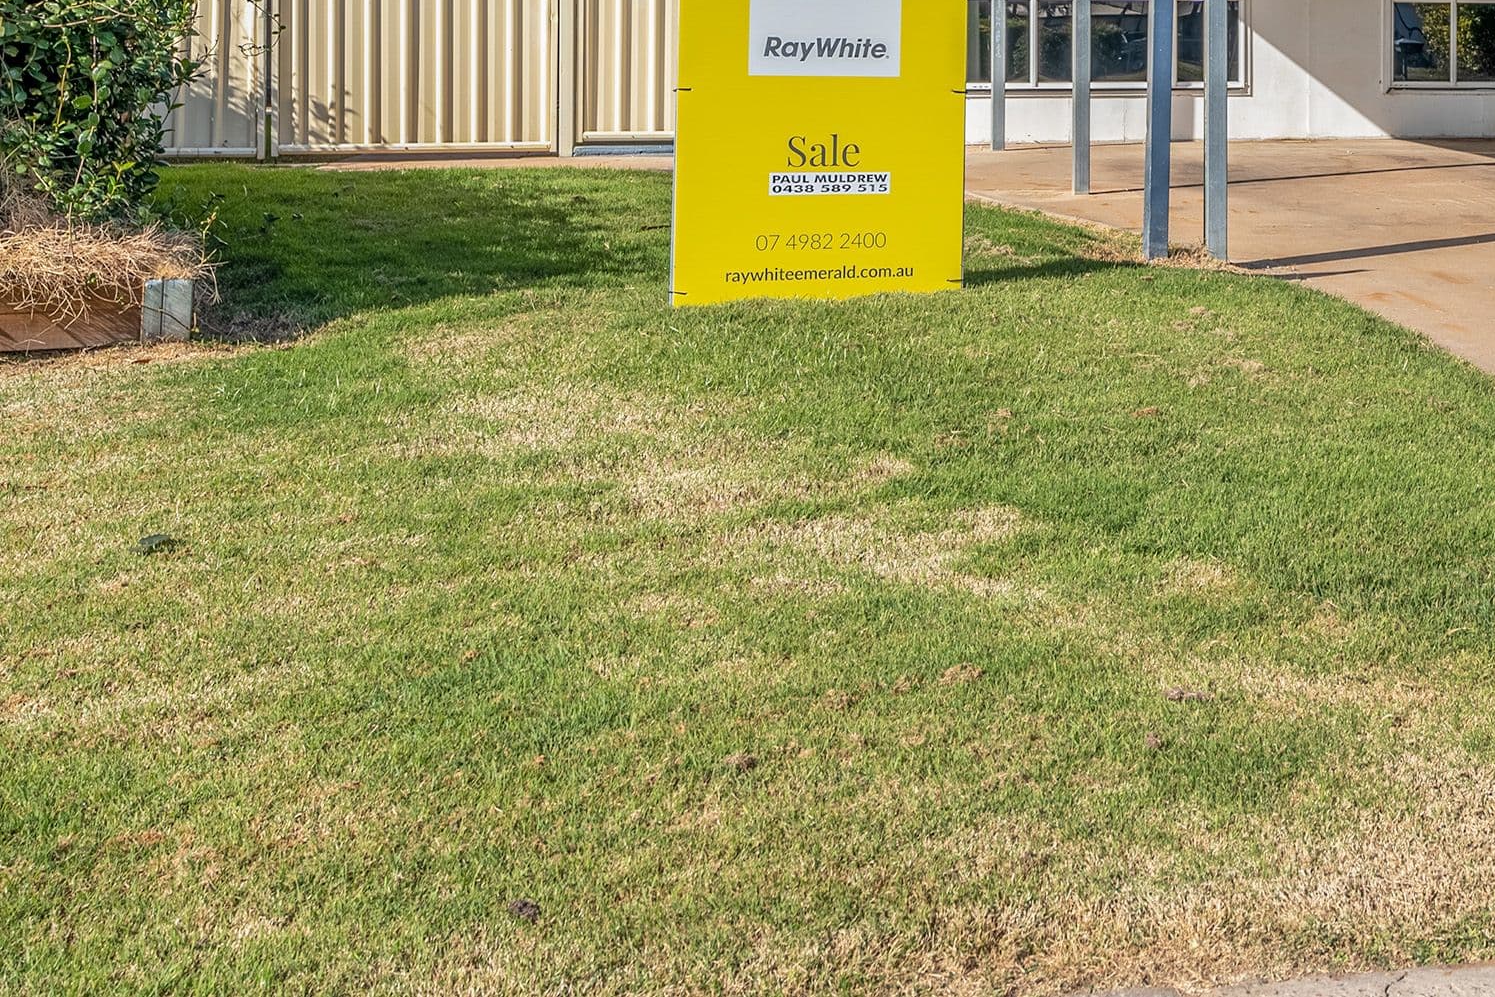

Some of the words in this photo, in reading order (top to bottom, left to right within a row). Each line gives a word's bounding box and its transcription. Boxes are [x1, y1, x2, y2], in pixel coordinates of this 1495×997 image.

[787, 133, 860, 167] Sale
[772, 175, 809, 184] PAUL
[814, 174, 888, 183] MULDREW
[772, 185, 814, 194] 0438
[820, 184, 852, 193] 589
[857, 183, 888, 192] 515
[755, 234, 780, 251] 07
[785, 233, 833, 250] 4982
[839, 232, 887, 249] 2400
[725, 265, 914, 284] raywhiteemerald.com.au
